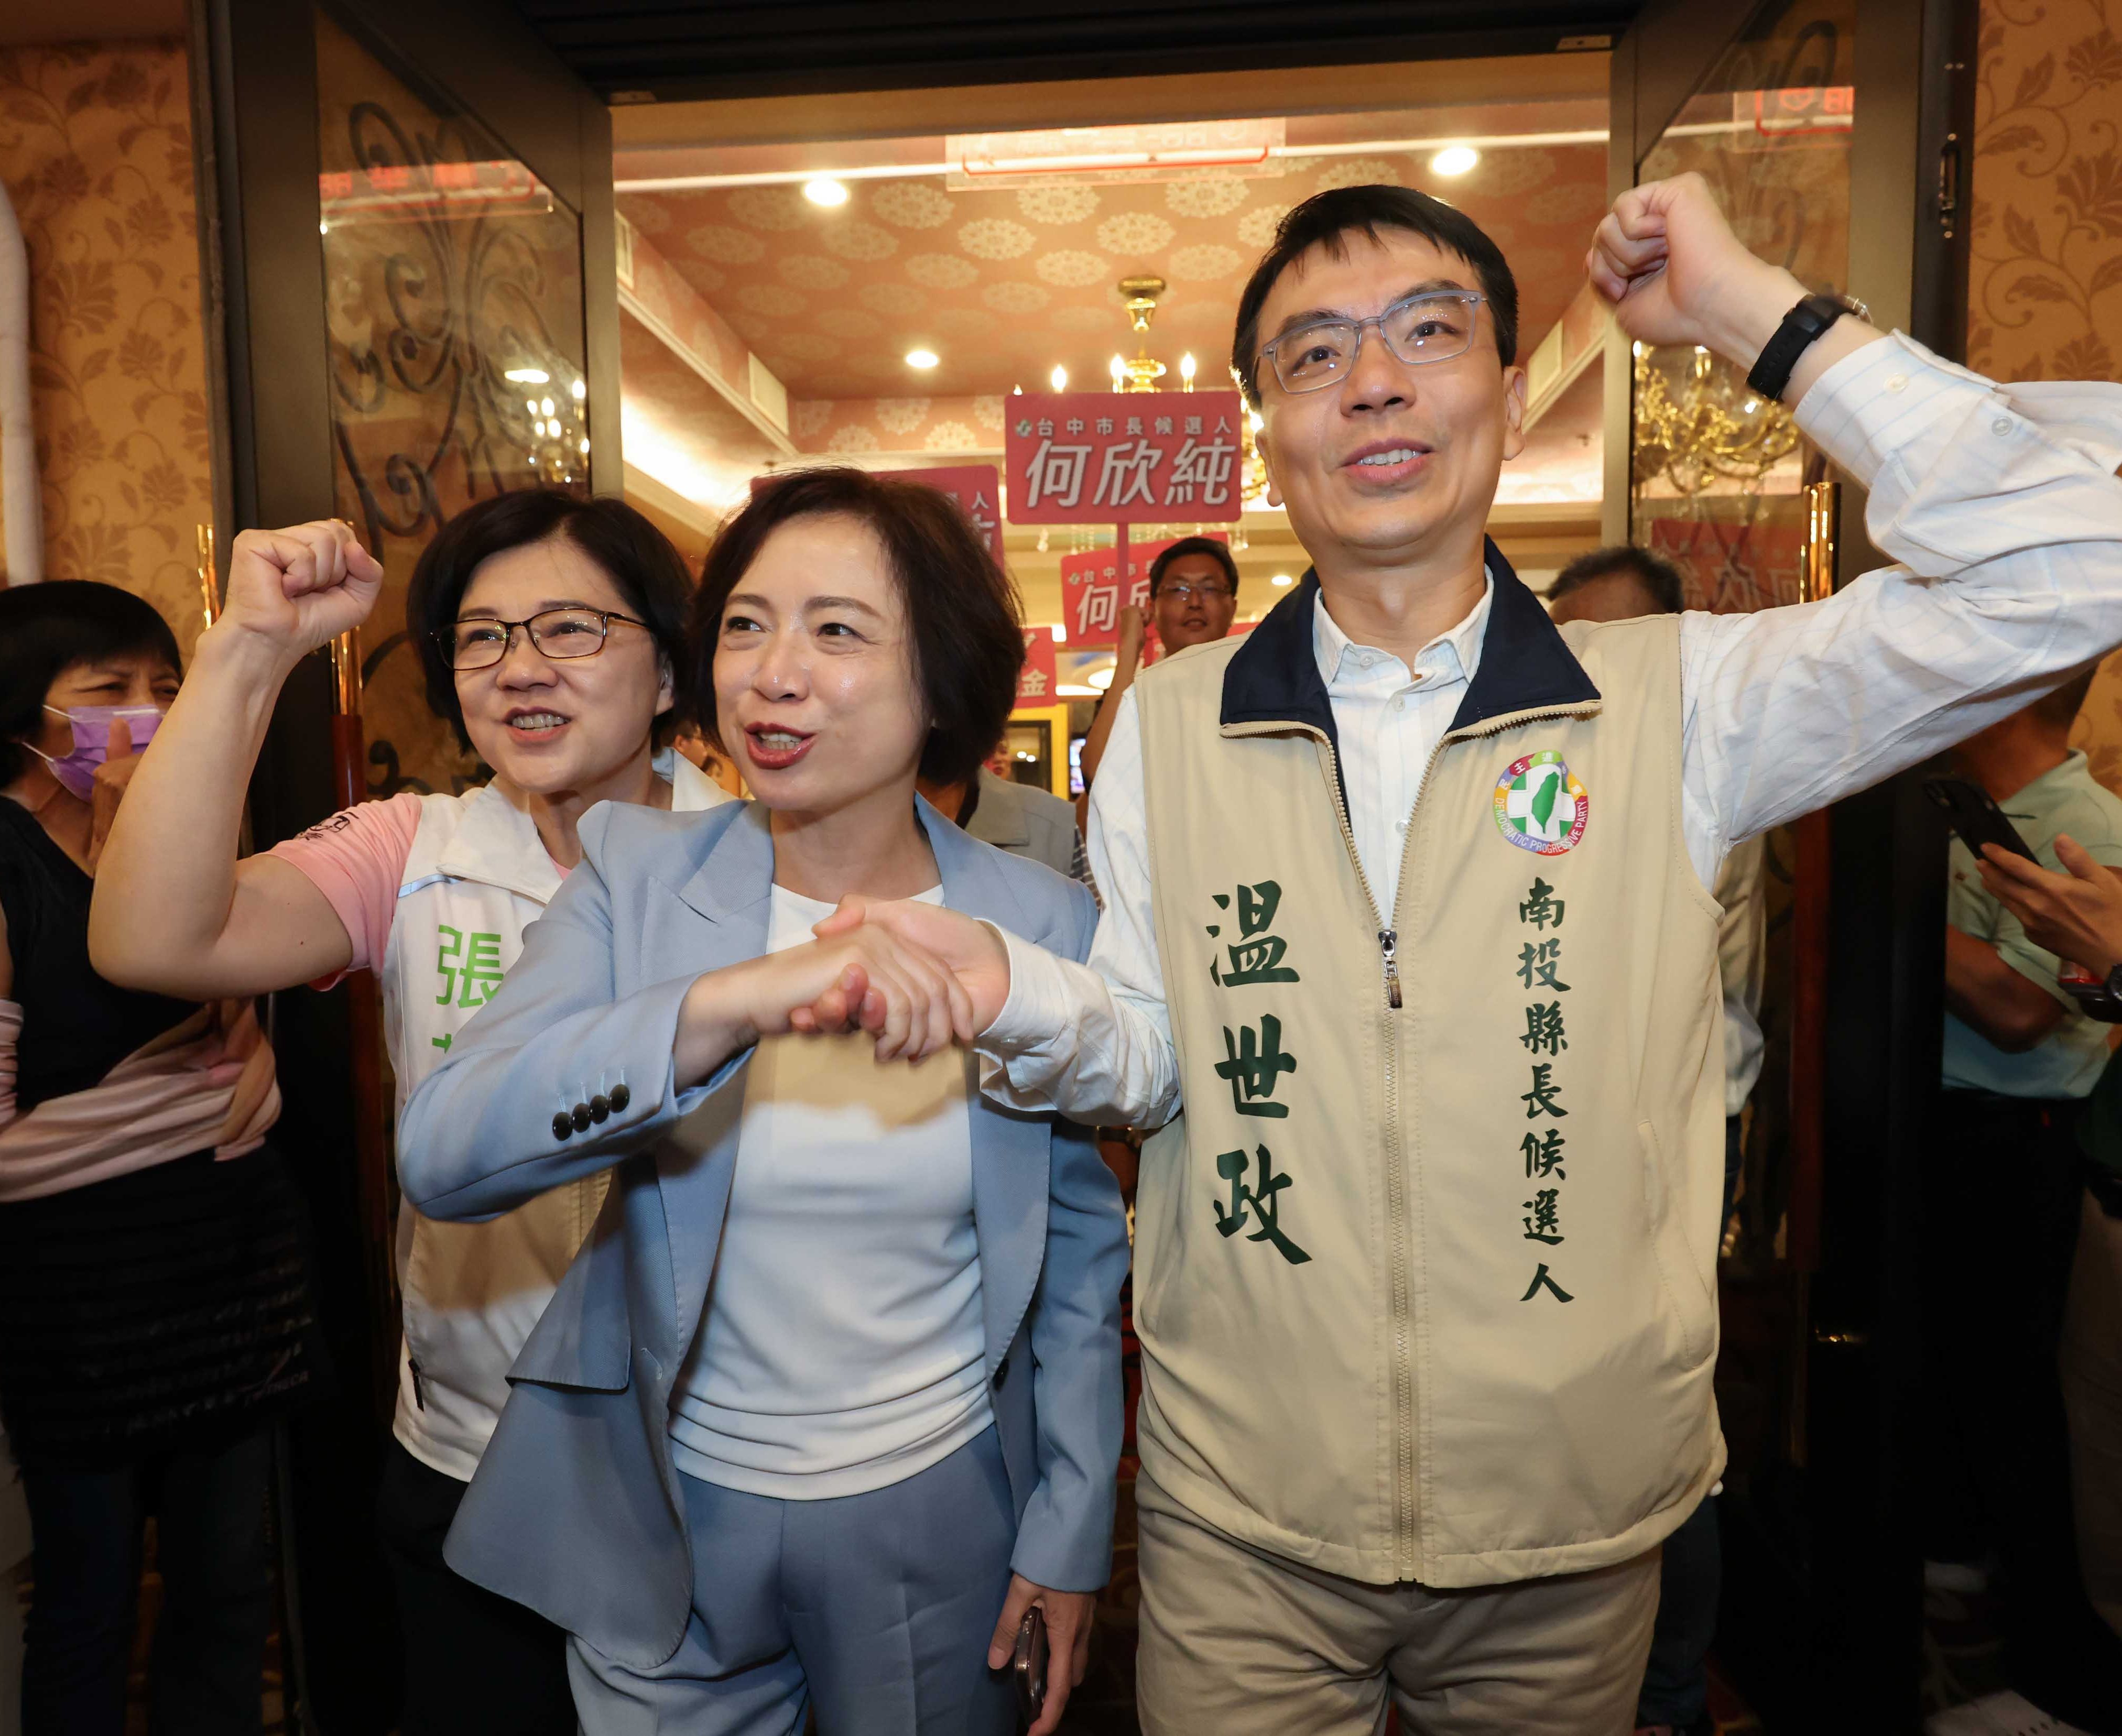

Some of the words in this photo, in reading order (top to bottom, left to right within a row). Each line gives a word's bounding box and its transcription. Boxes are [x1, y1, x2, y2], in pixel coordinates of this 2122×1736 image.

[1037, 416, 1232, 437] 台中市長候選人
[1025, 437, 1236, 508] 何欣純
[1495, 798, 1529, 847] DEMOCRATIC
[1530, 828, 1582, 854] PROGRESSIVE
[1575, 800, 1587, 828] PARTY
[1516, 876, 1575, 1303] 南投縣長候選人
